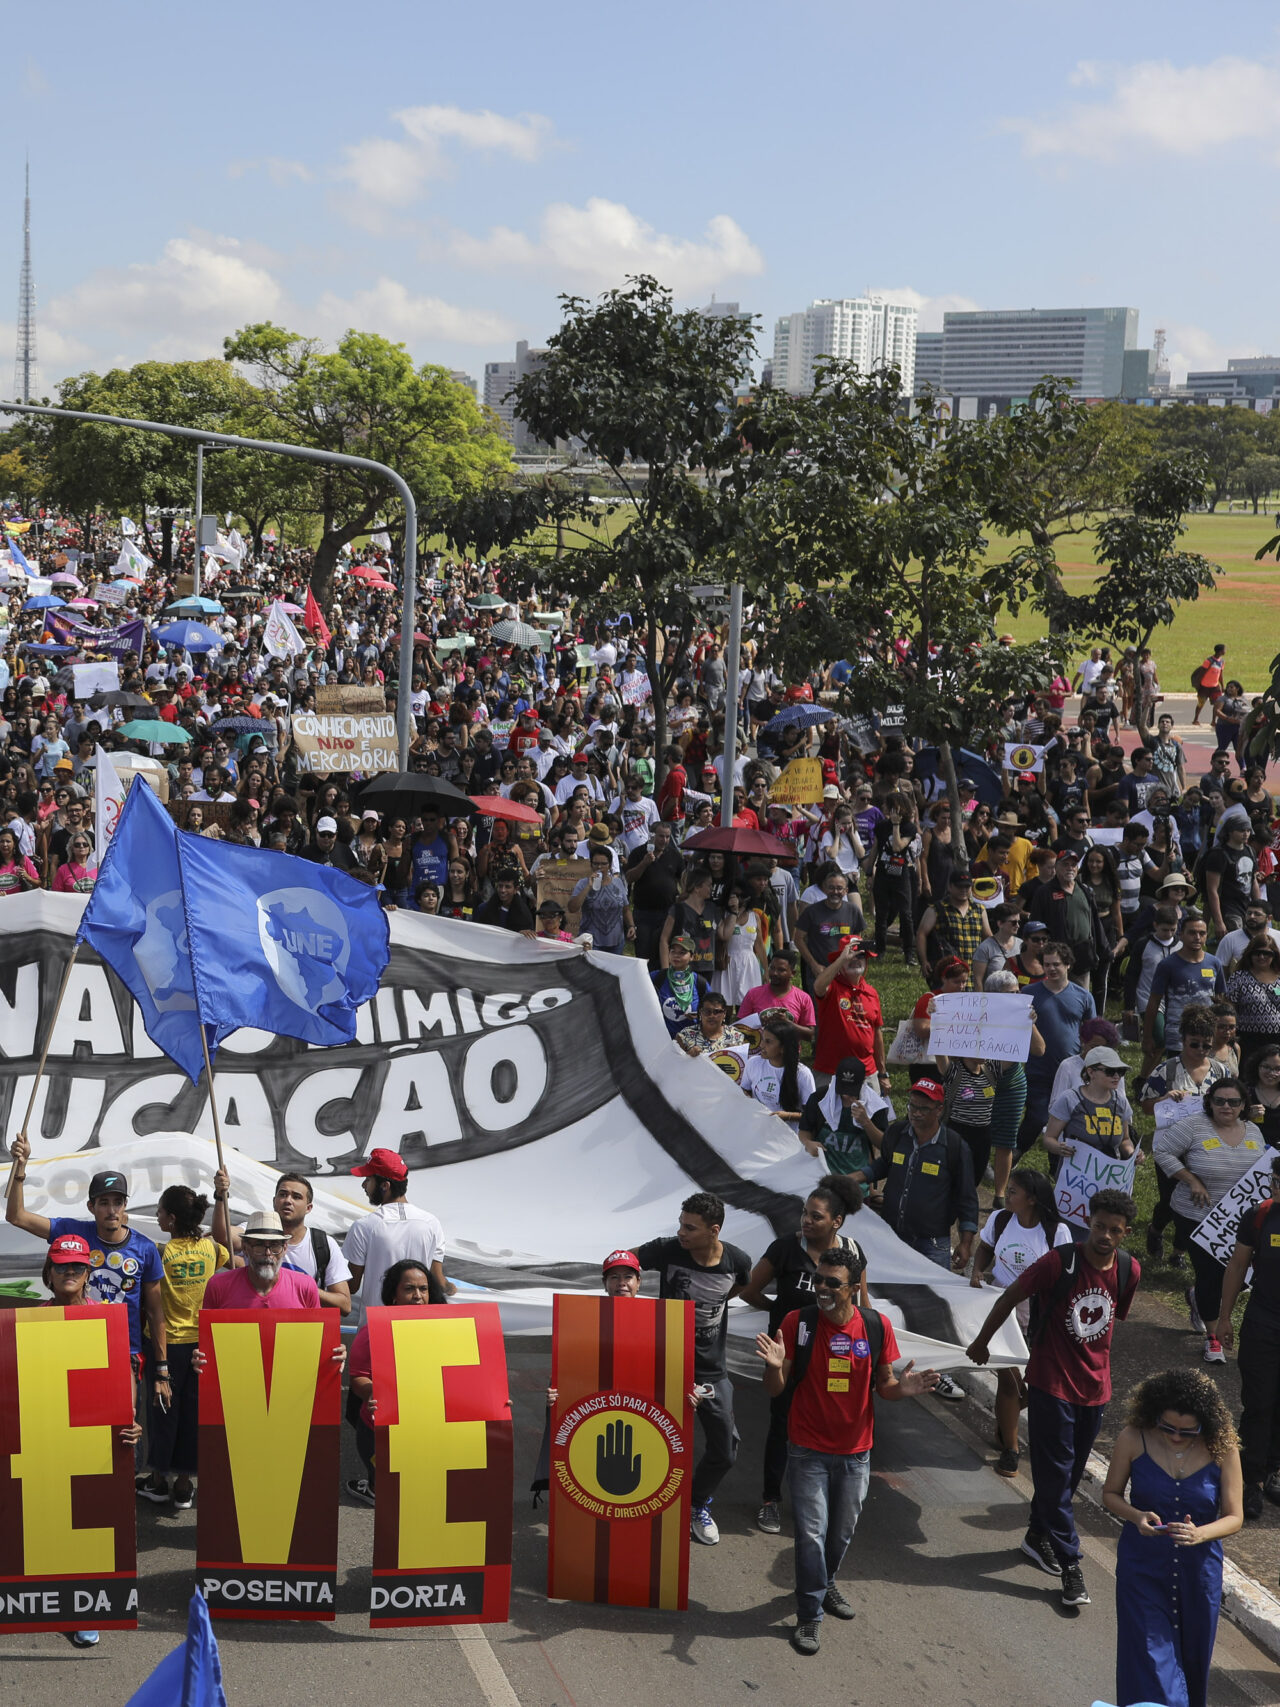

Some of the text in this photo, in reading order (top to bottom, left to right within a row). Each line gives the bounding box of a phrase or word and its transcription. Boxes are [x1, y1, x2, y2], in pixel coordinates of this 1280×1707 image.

[294, 715, 395, 738] CONHECIMENTO
[297, 748, 397, 772] MERCADORIA
[282, 928, 334, 959] UNE
[960, 996, 988, 1008] TIRO
[951, 1012, 988, 1022] AULA
[947, 1024, 981, 1035] AULA
[948, 1037, 1020, 1055] IGNORÂNCIA
[1066, 1169, 1098, 1199] VÃO
[1192, 1169, 1269, 1242] TIRE SUA
[171, 1261, 205, 1279] 30
[98, 1283, 117, 1294] UNE
[554, 1393, 684, 1453] NINGUÉM NASCE SÓ PARA TRABALHAR
[554, 1460, 684, 1518] APOSENTADORIA É DIREITO DO CIDADÃO
[73, 1590, 111, 1612] DA
[370, 1584, 466, 1609] DORIA
